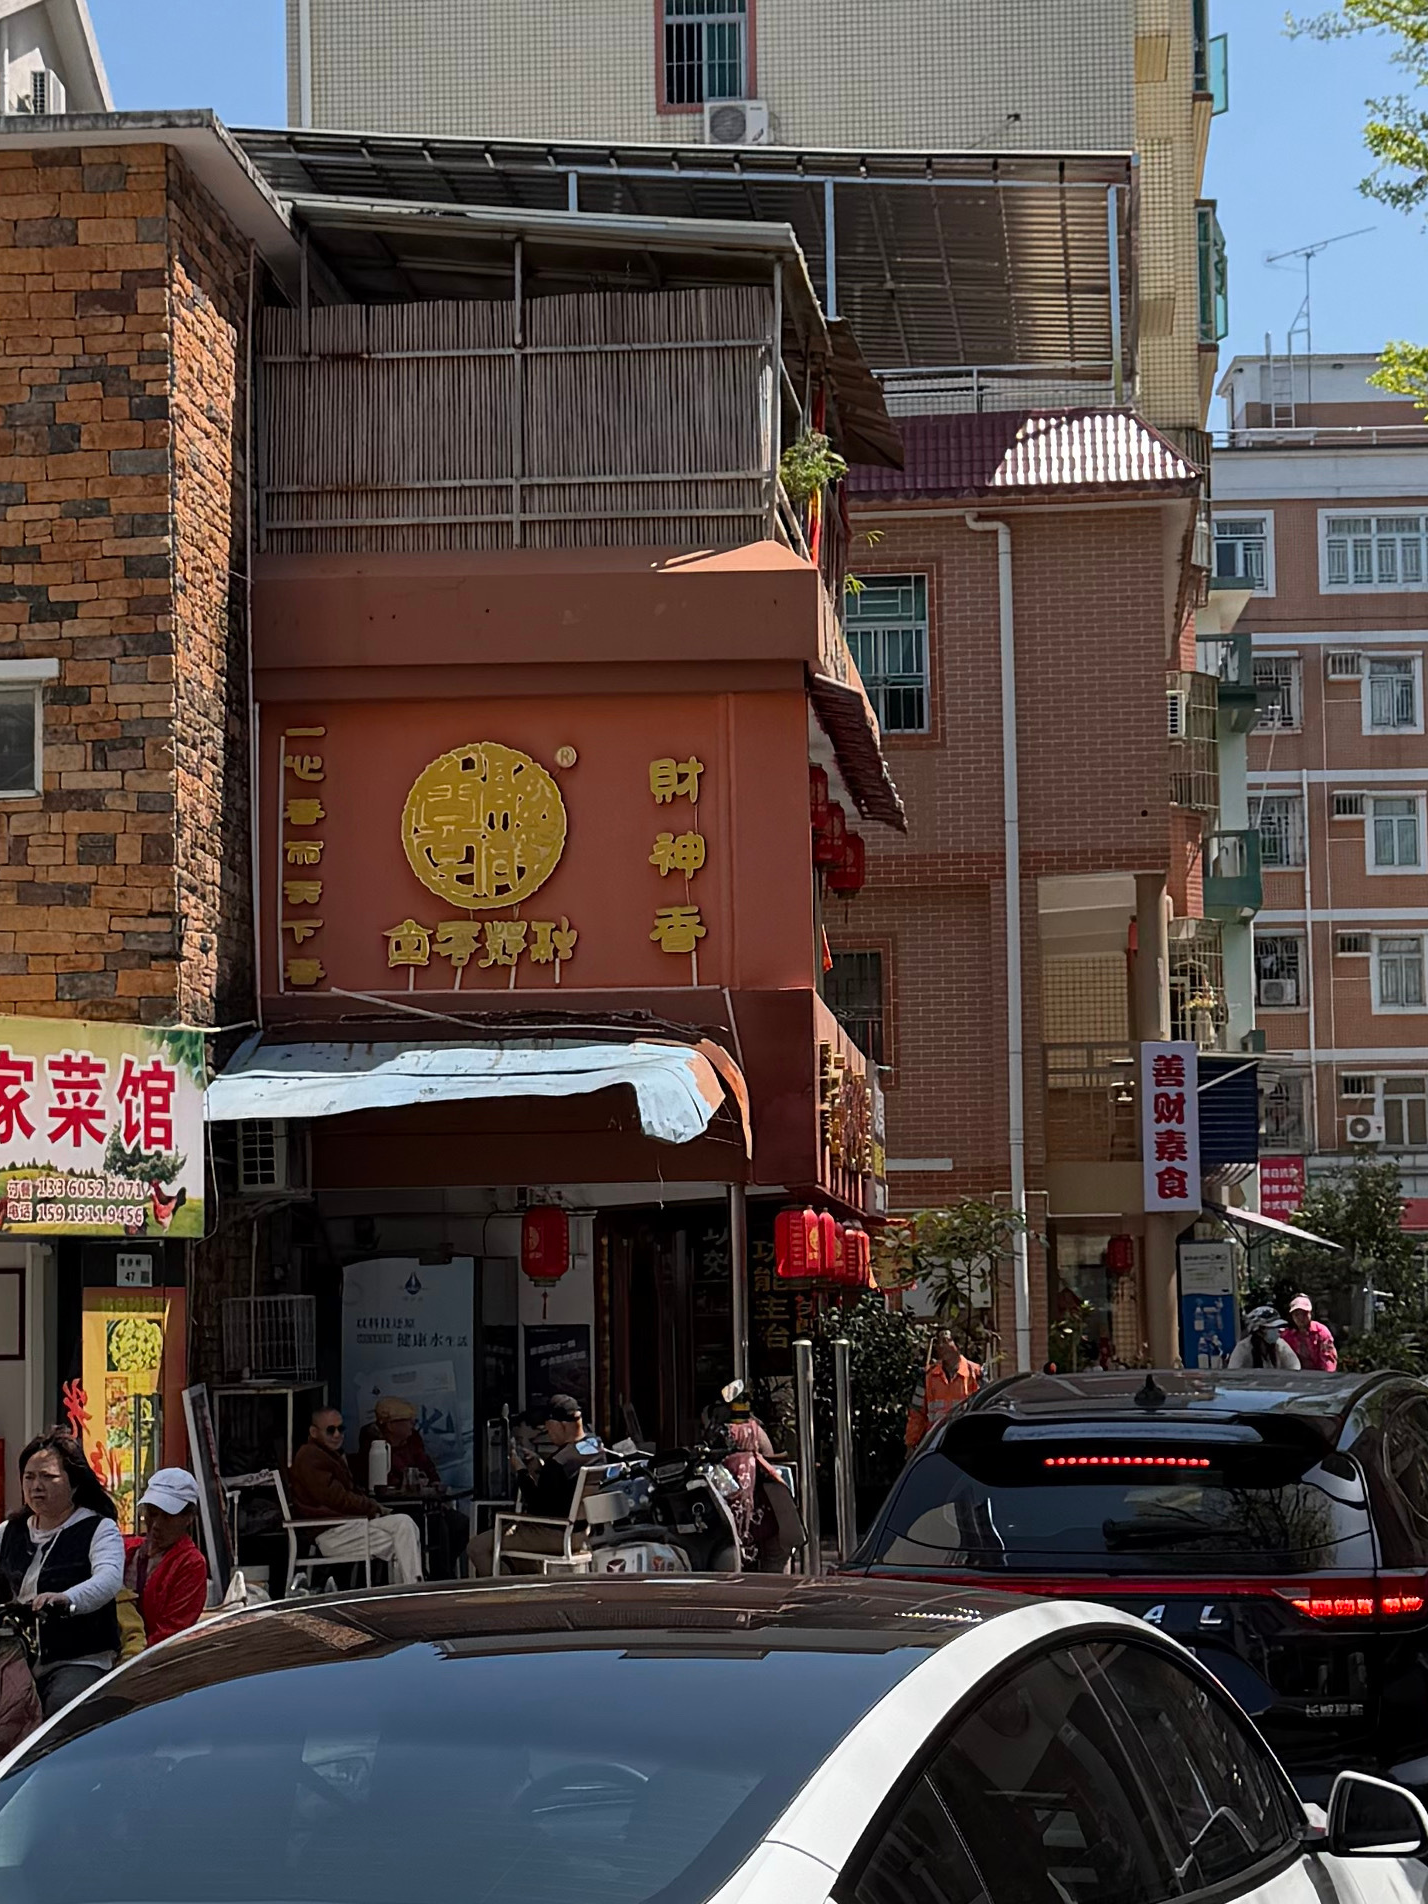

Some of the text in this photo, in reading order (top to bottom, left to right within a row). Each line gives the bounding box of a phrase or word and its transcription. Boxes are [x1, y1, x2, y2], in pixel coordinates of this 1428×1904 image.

[649, 755, 707, 953] 財神香
[1151, 1053, 1190, 1201] 善财素食
[37, 1203, 66, 1223] 159
[68, 1204, 105, 1224] 1311
[106, 1205, 145, 1226] 9456
[68, 1179, 105, 1198] 6052
[108, 1180, 145, 1200] 2071
